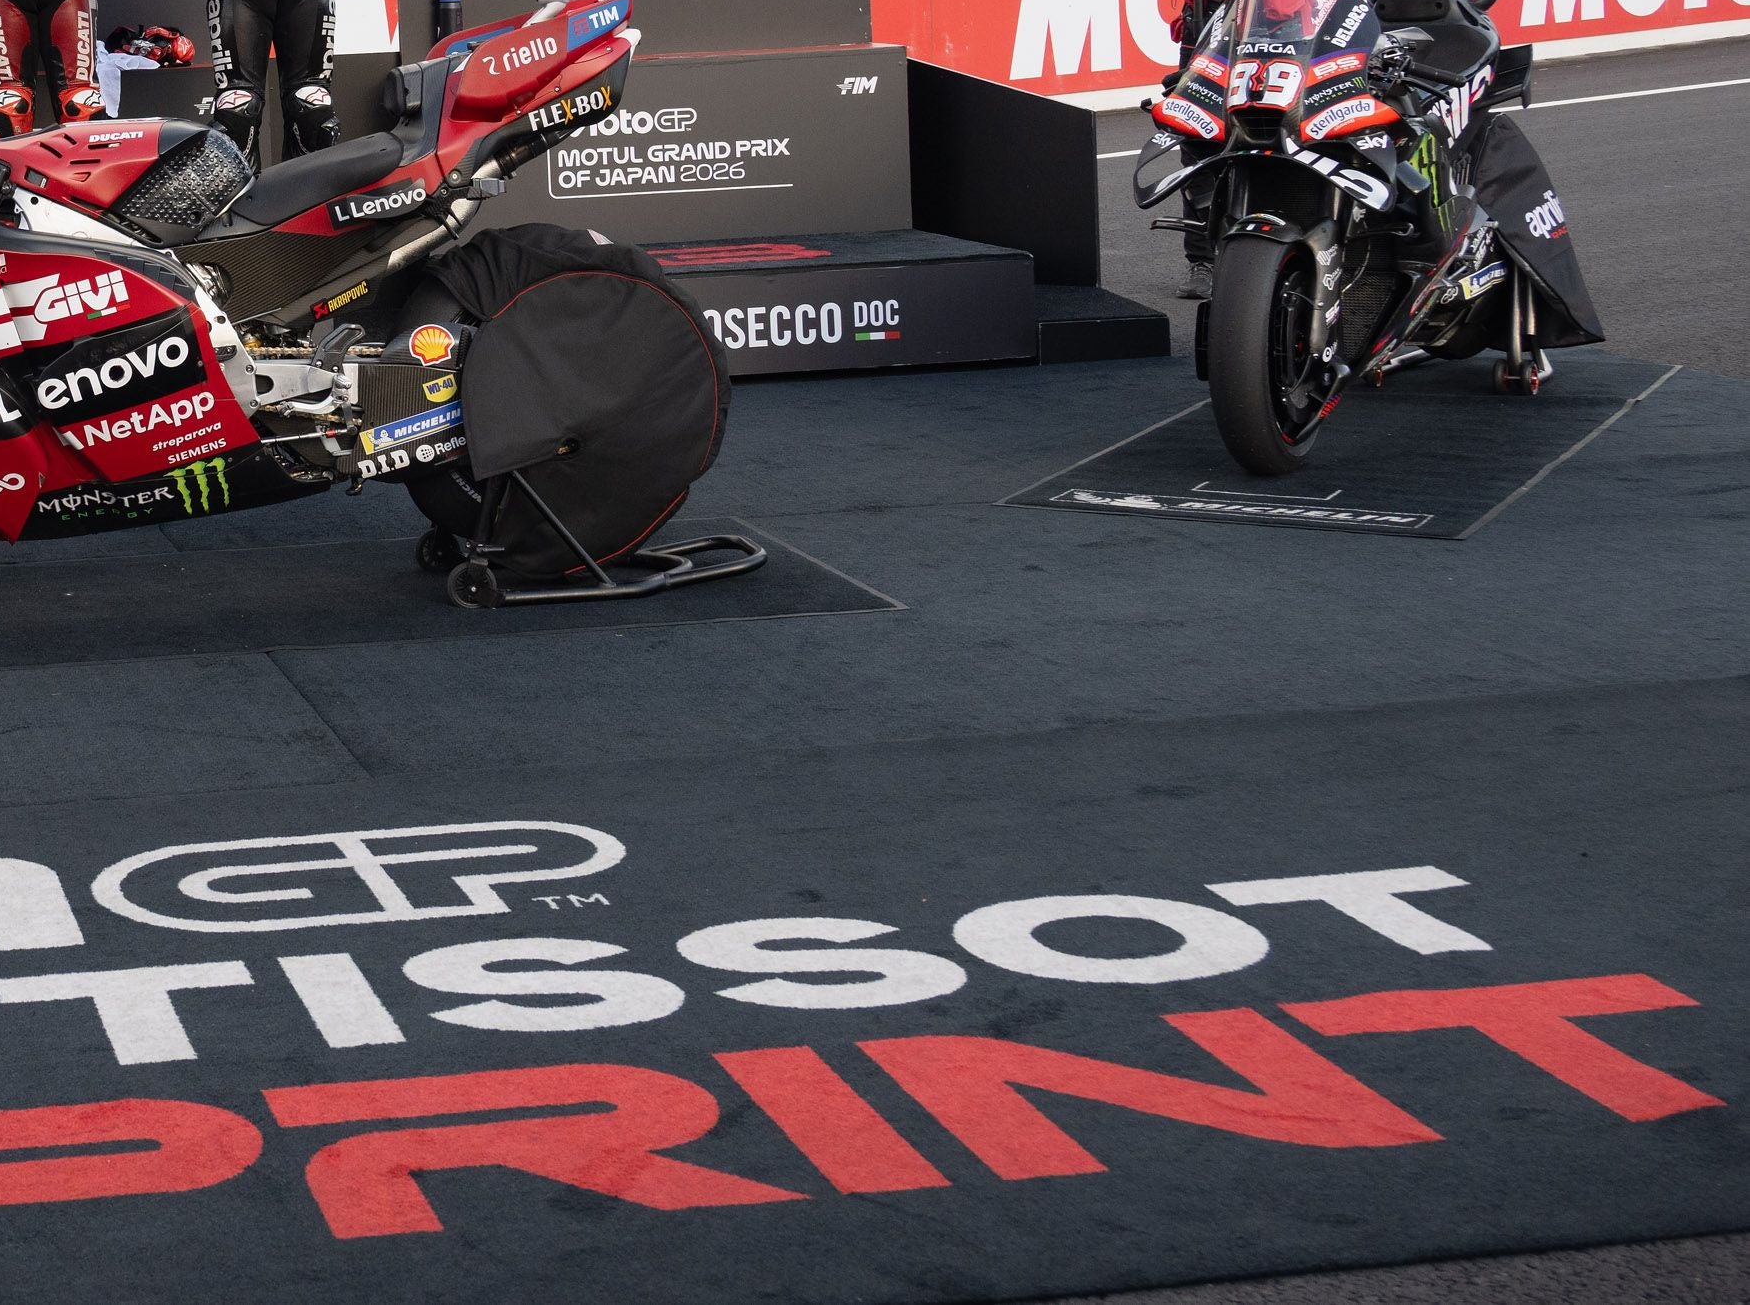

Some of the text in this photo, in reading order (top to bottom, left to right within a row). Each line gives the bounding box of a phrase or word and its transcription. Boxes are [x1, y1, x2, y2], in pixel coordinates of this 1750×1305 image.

[588, 5, 620, 29] TIM
[76, 10, 89, 81] DUCATI
[502, 36, 558, 72] riello
[1236, 43, 1297, 56] TARGA
[1191, 56, 1226, 77] BS
[1312, 56, 1361, 77] BS
[836, 76, 878, 95] FIM
[1186, 80, 1225, 105] MONSTER
[1304, 80, 1354, 105] MONSTER
[528, 86, 613, 132] FLEX-BOX
[1164, 100, 1216, 137] sterilgarda
[1309, 99, 1372, 136] sterilgarda
[89, 131, 143, 142] DUCATI
[1151, 132, 1177, 148] sky
[1356, 133, 1388, 151] sky
[558, 137, 791, 168] MOTUL GRAND PRIX
[558, 161, 746, 189] OF JAPAN 2026
[34, 269, 130, 323] GIVI
[853, 299, 901, 327] DOC
[425, 377, 455, 396] WD-40
[83, 390, 215, 451] NetApp
[394, 407, 461, 439] MICHELIN
[152, 422, 222, 452] streparava
[167, 437, 227, 464] SIEMENS
[358, 449, 411, 479] D.I.D
[38, 485, 175, 513] MONSTER
[1172, 501, 1420, 524] MICHELIN
